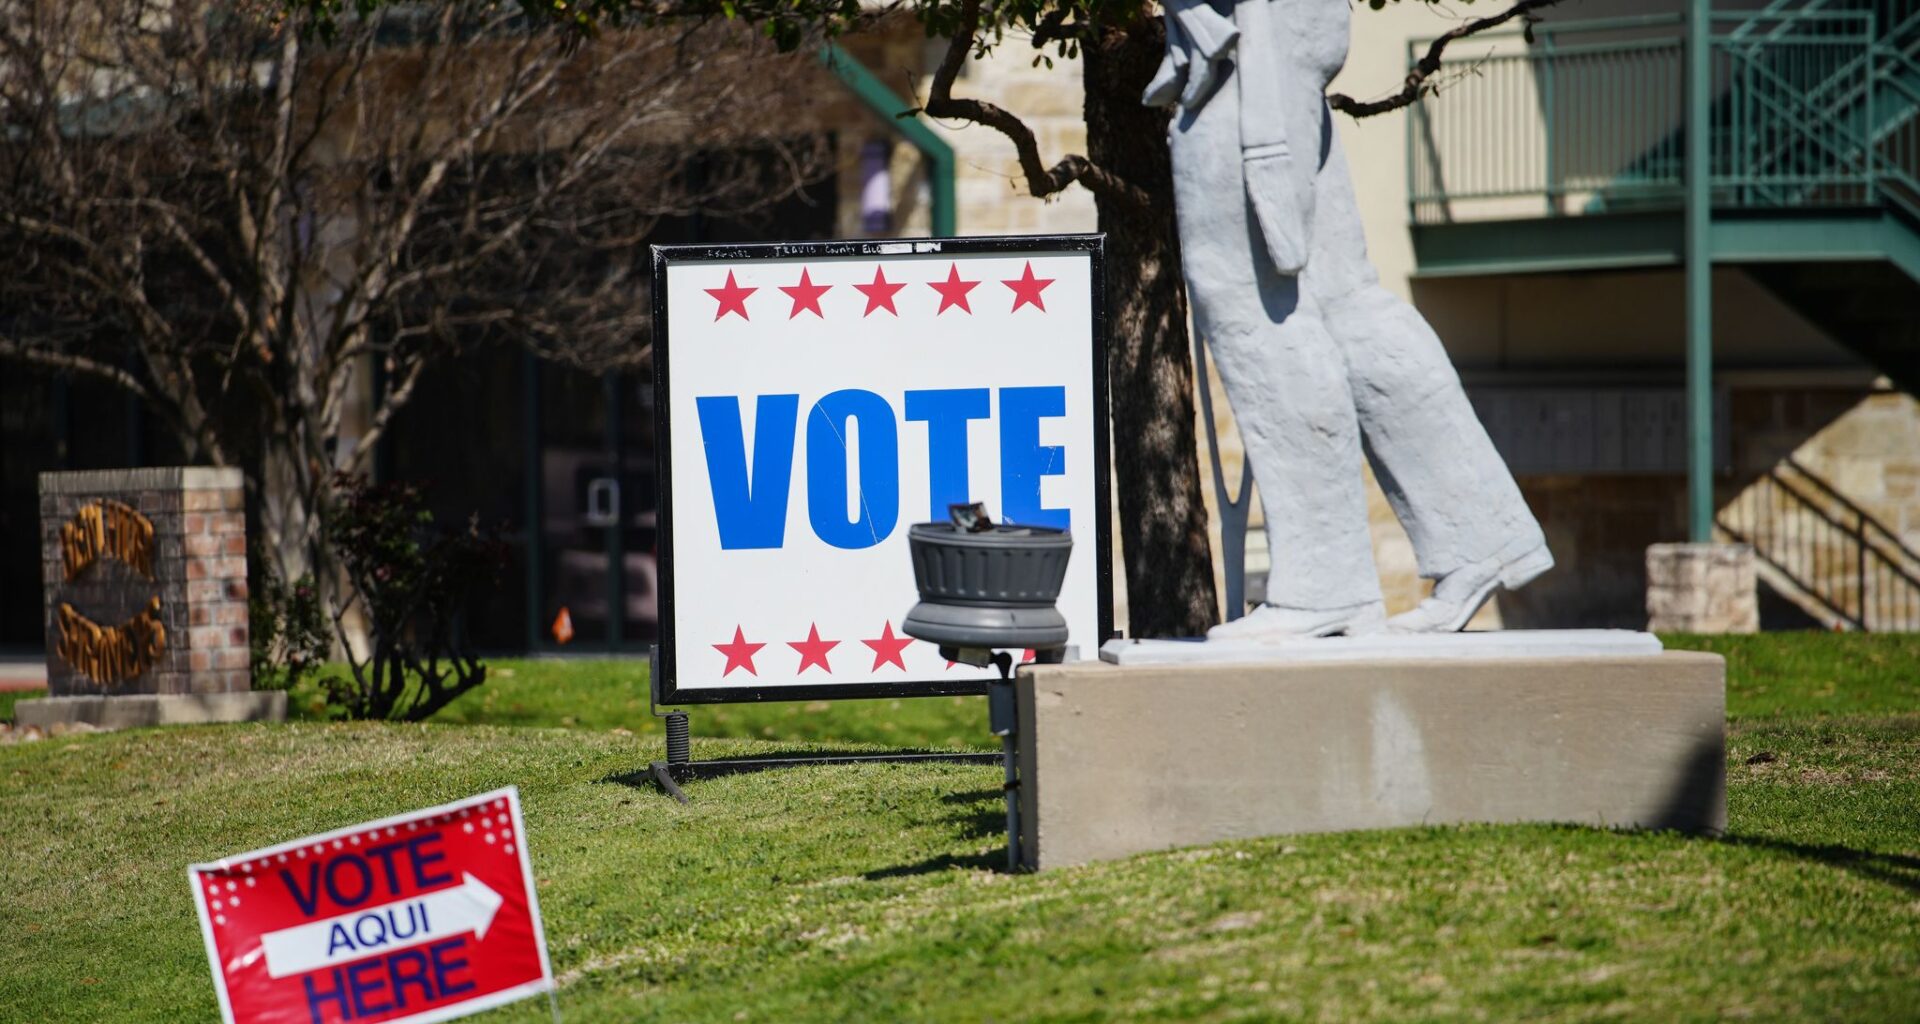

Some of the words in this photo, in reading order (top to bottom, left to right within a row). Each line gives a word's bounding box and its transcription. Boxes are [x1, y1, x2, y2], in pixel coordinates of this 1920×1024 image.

[695, 386, 1071, 549] VOTE
[279, 832, 454, 917] VOTE
[327, 902, 430, 956] AQUI
[303, 938, 476, 1024] HERE
